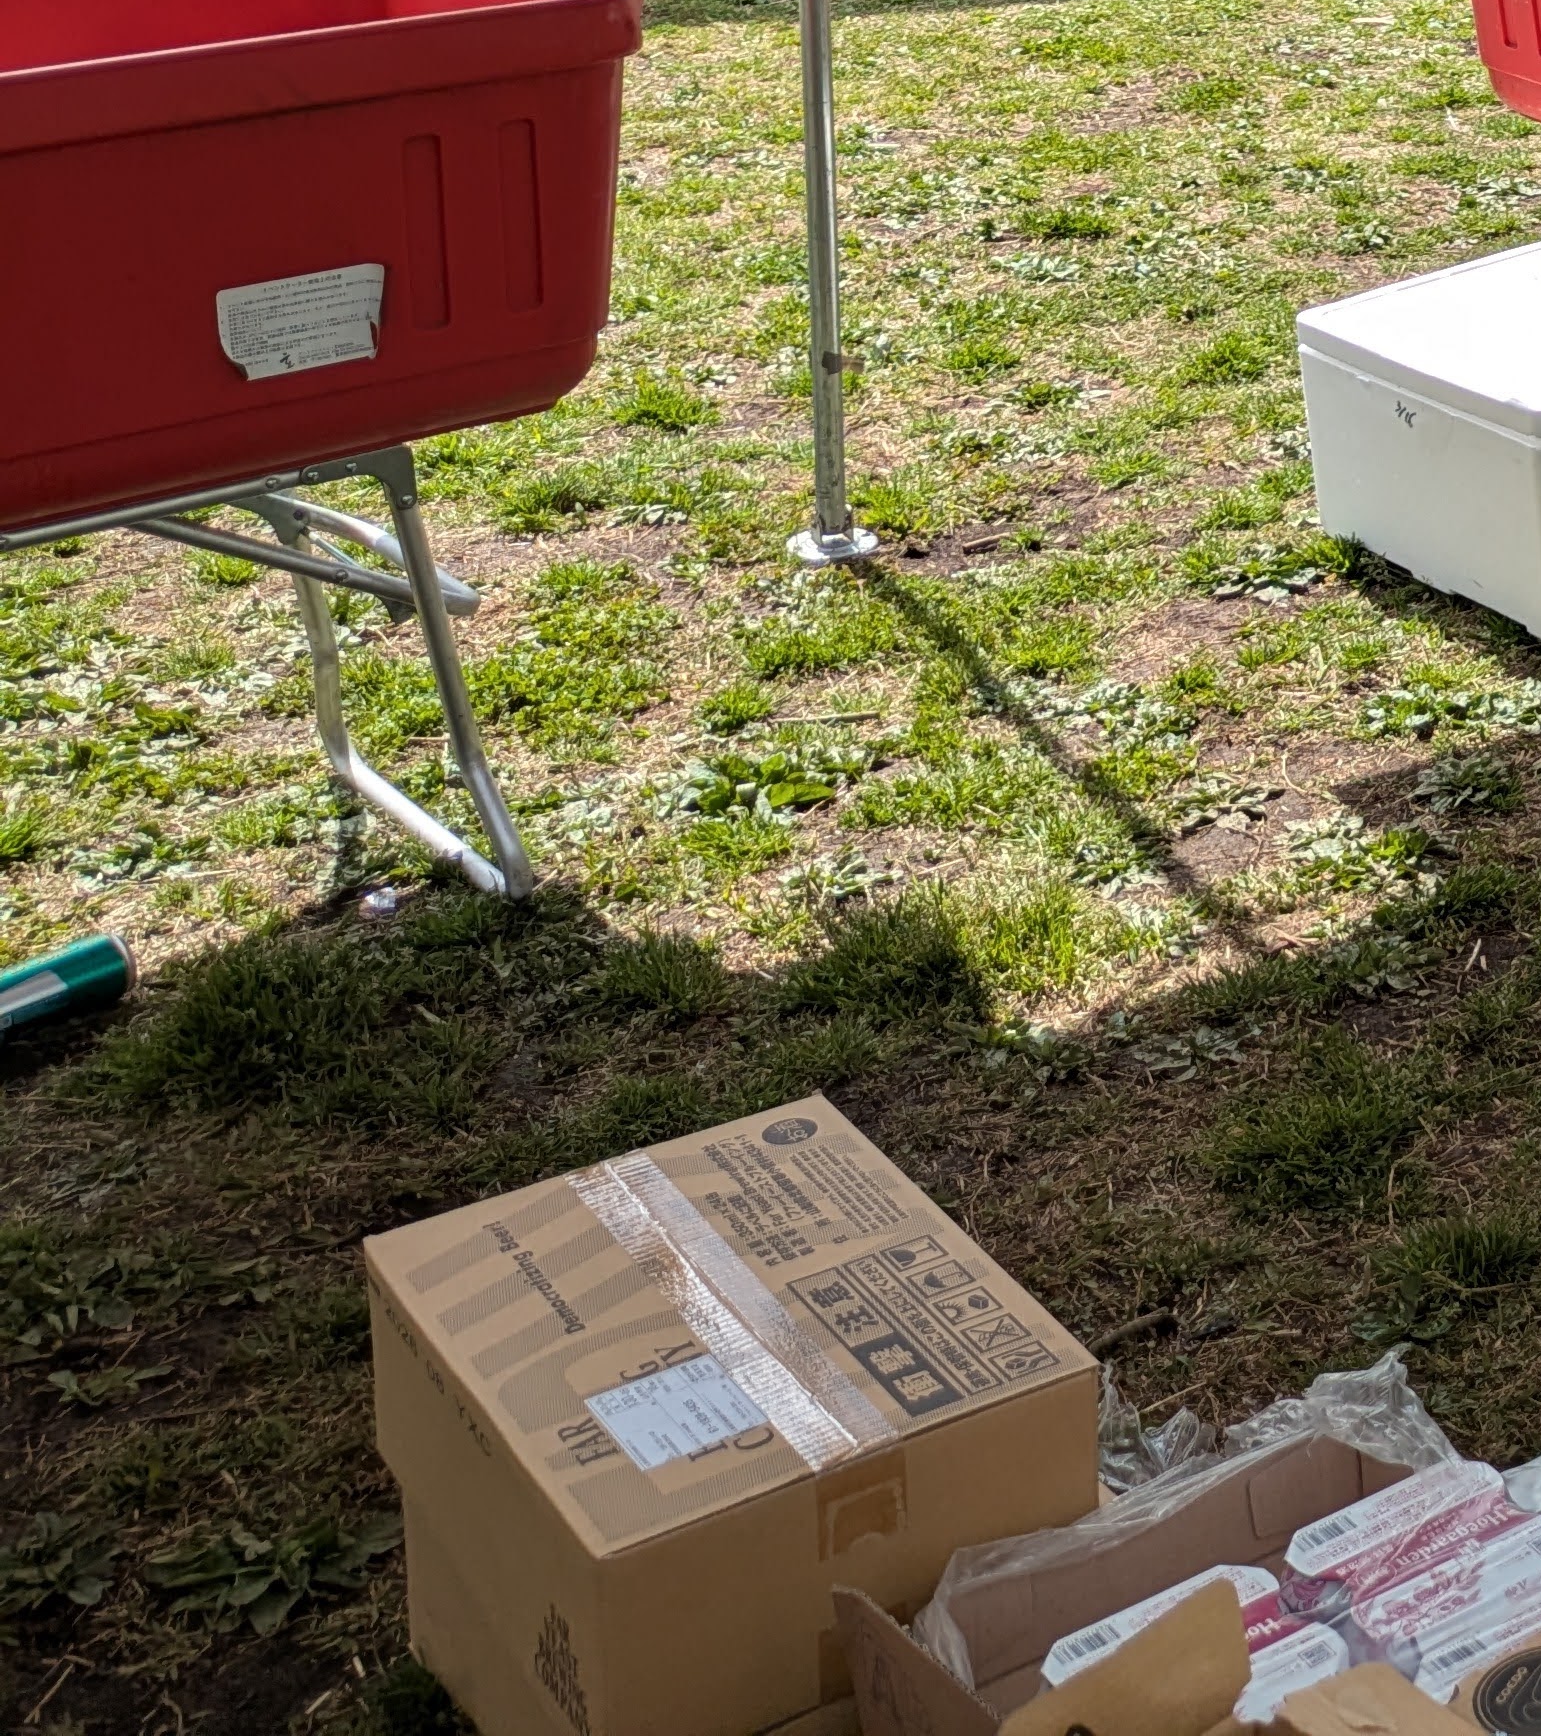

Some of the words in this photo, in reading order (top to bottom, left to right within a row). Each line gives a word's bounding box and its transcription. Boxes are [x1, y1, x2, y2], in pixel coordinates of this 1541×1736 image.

[511, 1240, 584, 1336] Democratizing
[803, 1279, 945, 1406] 衝撃注意
[557, 1410, 616, 1467] FAR
[1400, 1501, 1510, 1569] Hoegaarden
[1495, 1666, 1529, 1705] COEDO
